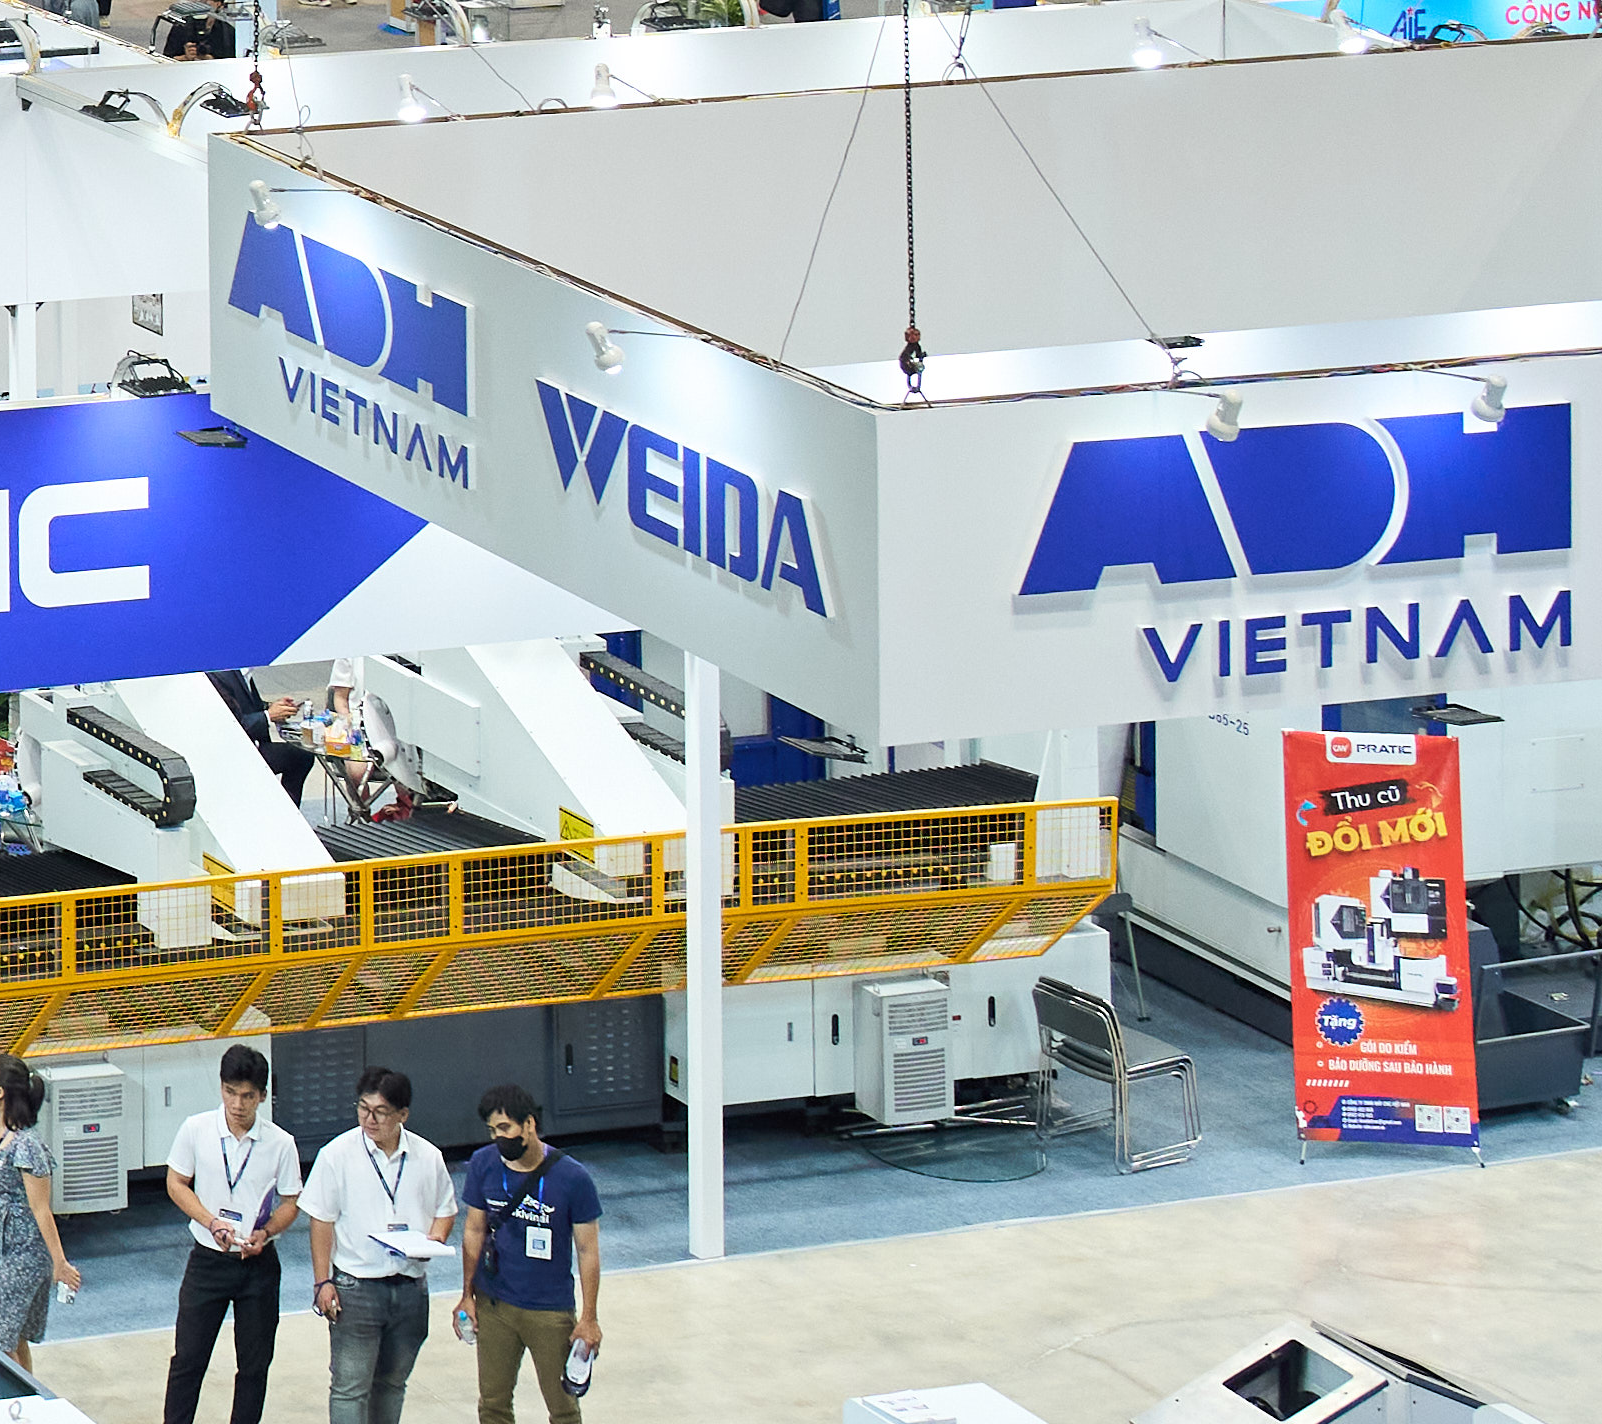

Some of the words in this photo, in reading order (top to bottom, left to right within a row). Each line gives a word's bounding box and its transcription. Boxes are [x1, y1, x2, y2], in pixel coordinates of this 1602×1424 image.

[227, 210, 471, 418] ADH
[277, 356, 472, 492] VIETNAM
[535, 377, 829, 618] WEIDA
[1018, 402, 1573, 597] ADH
[1142, 588, 1573, 685] VIETNAM
[1331, 788, 1371, 811] Thu
[1376, 784, 1402, 805] cũ
[1356, 743, 1413, 756] PRATIC
[1305, 816, 1374, 857] ĐỔI
[1377, 806, 1449, 846] MỚI
